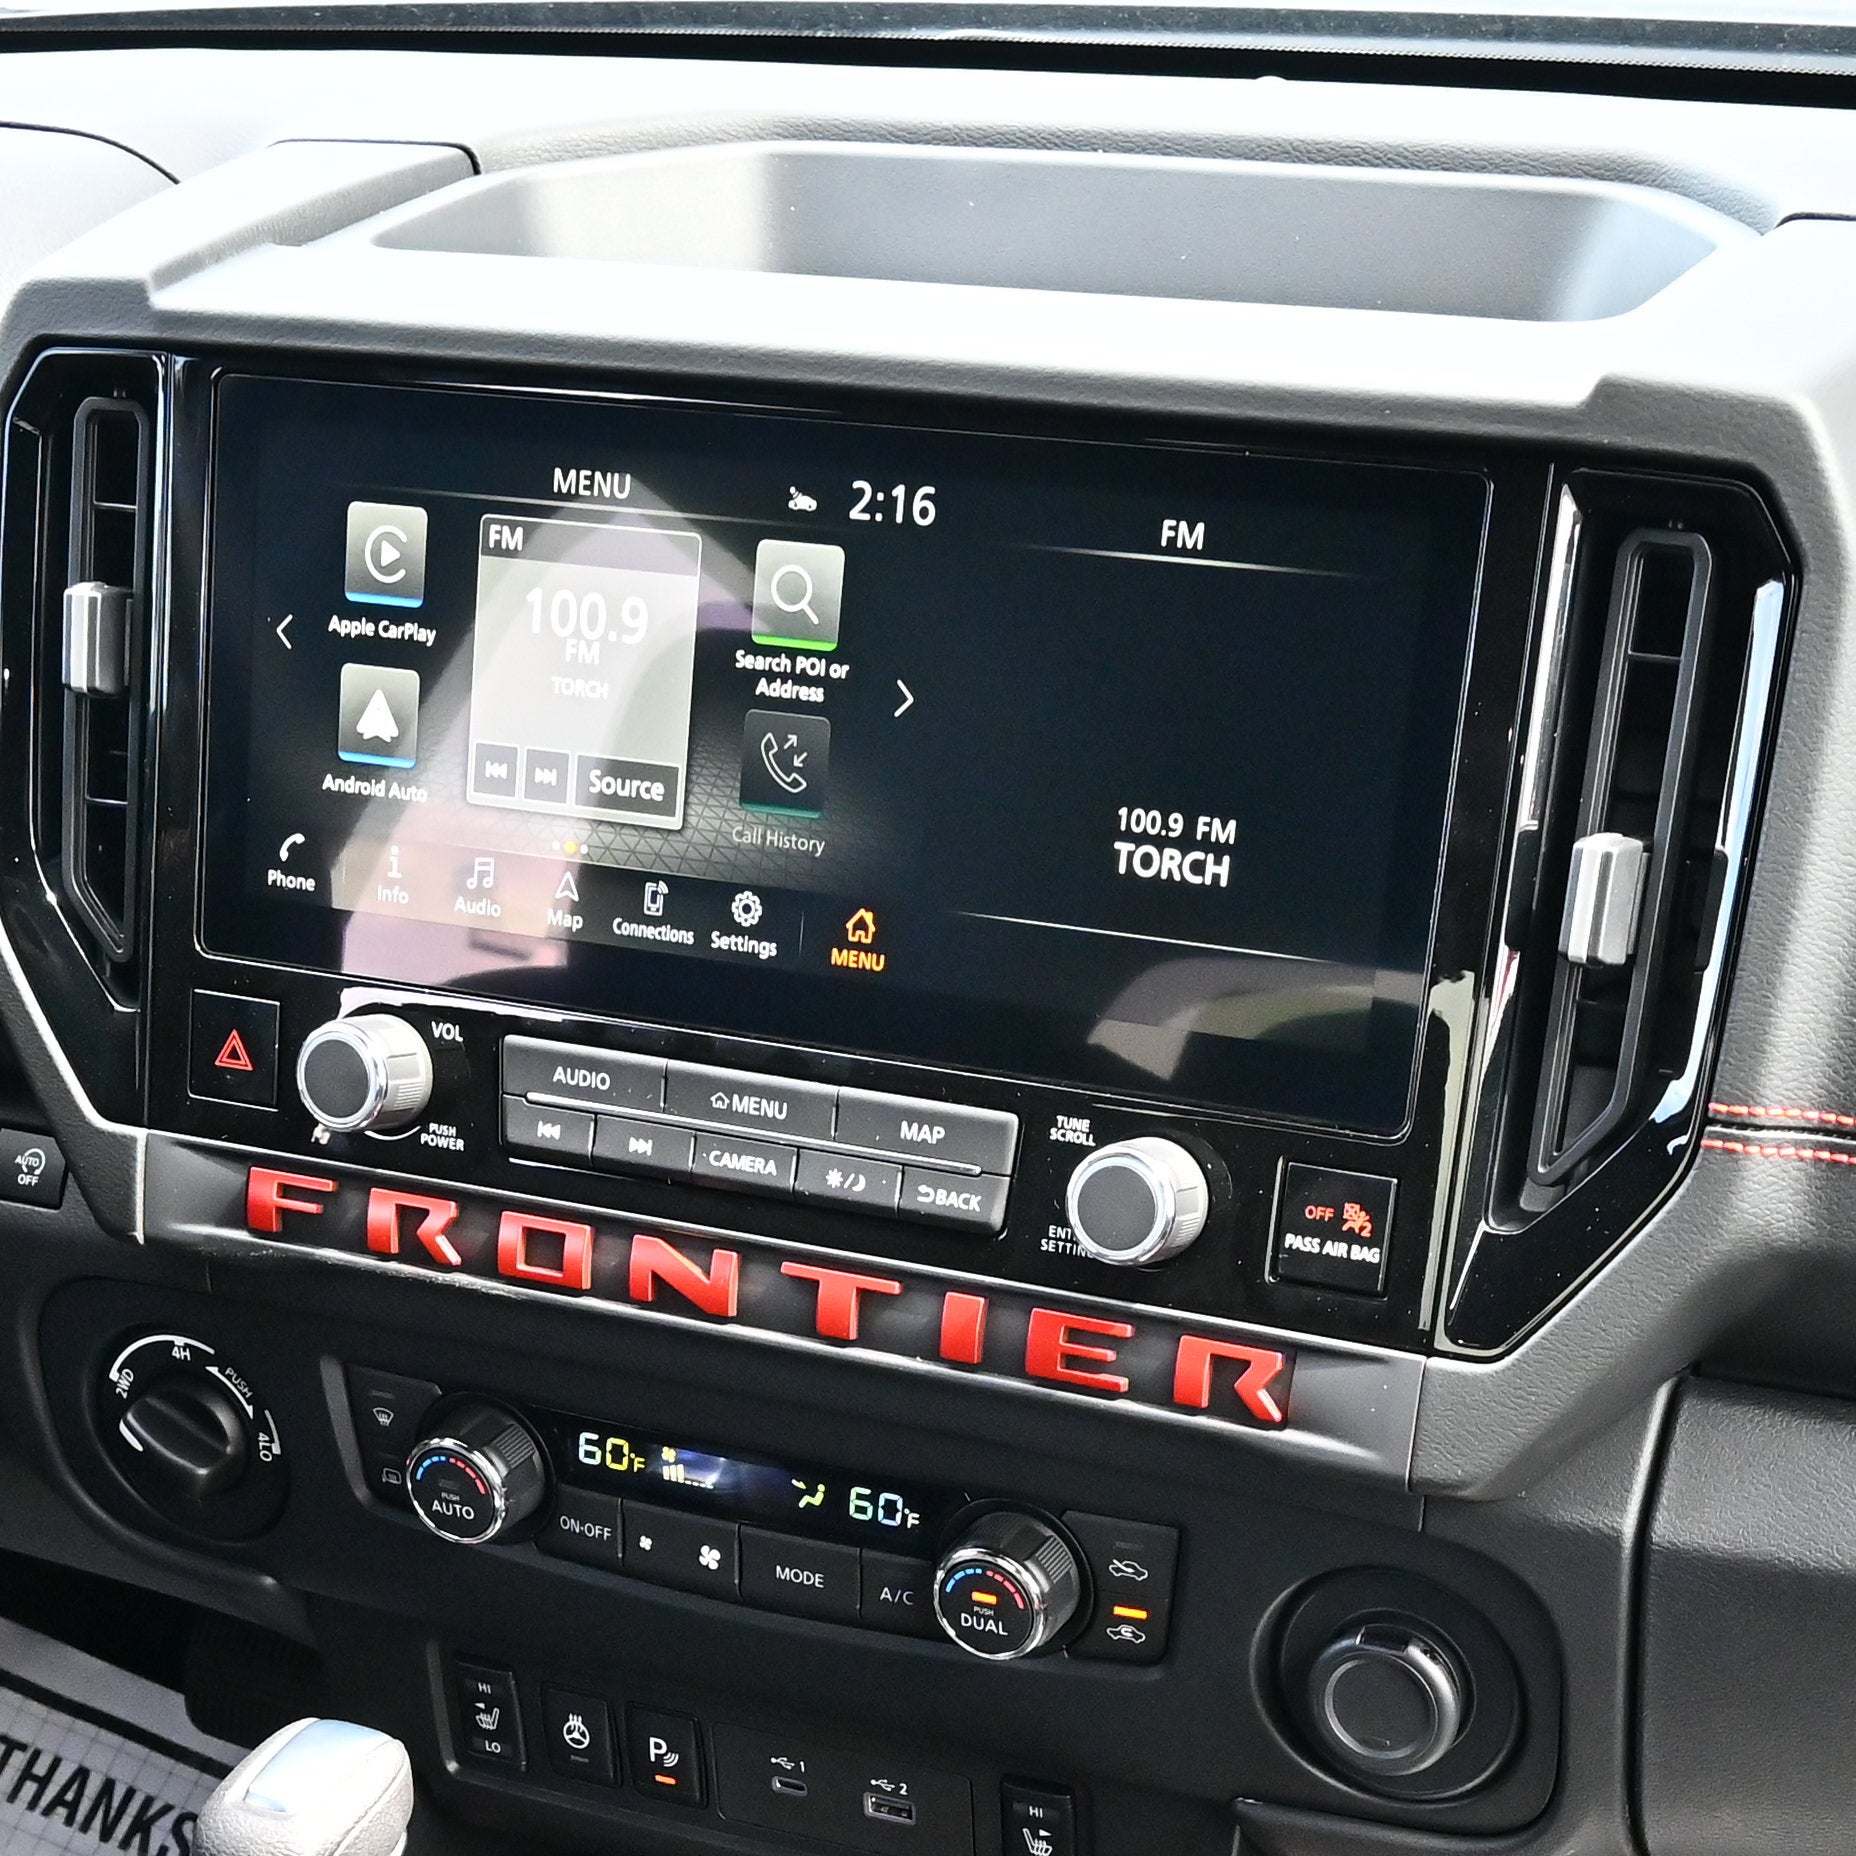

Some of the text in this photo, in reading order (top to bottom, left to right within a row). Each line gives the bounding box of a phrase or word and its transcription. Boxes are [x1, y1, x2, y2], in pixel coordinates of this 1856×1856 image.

[552, 467, 632, 500] MENU
[848, 480, 938, 527] 2:16
[489, 525, 524, 552] FM
[1161, 520, 1206, 551] FM
[525, 587, 649, 645] 100.9
[328, 615, 437, 647] Apple CarPlay
[565, 639, 601, 665] FM
[735, 650, 849, 679] Search POI or
[552, 677, 609, 701] TORCH
[755, 678, 824, 703] Address
[322, 773, 428, 802] Android Auto
[589, 768, 665, 802] Source
[1118, 806, 1237, 845] 100.9 FM
[732, 826, 826, 857] Call History
[1114, 841, 1231, 888] TORCH
[267, 868, 316, 893] Phone
[377, 883, 410, 907] Info
[454, 895, 503, 919] Audio
[548, 909, 583, 933] Map
[613, 917, 695, 946] Connections
[711, 931, 778, 960] Settings
[830, 947, 886, 972] MENU
[432, 1021, 463, 1042] VOL
[553, 1067, 611, 1093] AUDIO
[731, 1092, 788, 1121] MENU
[429, 1123, 456, 1137] PUSH
[900, 1121, 945, 1144] MAP
[1056, 1115, 1090, 1132] TUNE
[420, 1133, 465, 1151] POWER
[1050, 1128, 1096, 1146] SCROLL
[15, 1153, 40, 1169] AUTO
[710, 1151, 777, 1177] CAMERA
[17, 1173, 39, 1187] OFF
[936, 1187, 982, 1211] BACK
[1305, 1204, 1334, 1222] OFF
[1285, 1233, 1380, 1264] PASS AIR BAG
[247, 1166, 1287, 1422] FRONTIER
[171, 1346, 192, 1361] 4H
[115, 1369, 135, 1399] 2WD
[224, 1367, 254, 1400] PUSH
[256, 1431, 274, 1463] 4LO
[432, 1500, 475, 1520] AUTO
[776, 1566, 825, 1589] MODE
[880, 1587, 914, 1606] A/C
[961, 1613, 1008, 1635] DUAL
[478, 1683, 491, 1695] HI
[485, 1740, 501, 1754] LO
[1029, 1806, 1043, 1818] HI
